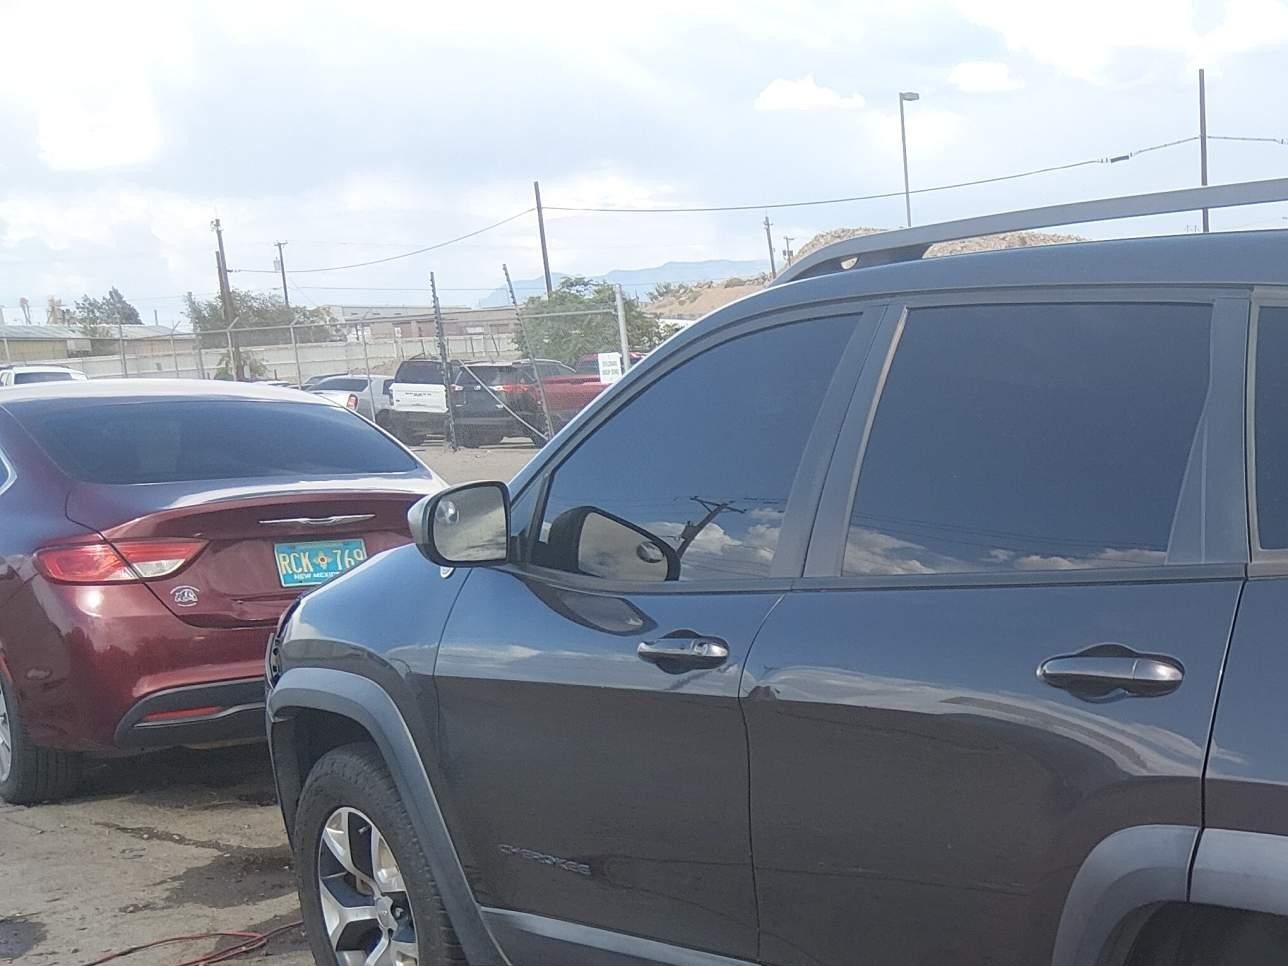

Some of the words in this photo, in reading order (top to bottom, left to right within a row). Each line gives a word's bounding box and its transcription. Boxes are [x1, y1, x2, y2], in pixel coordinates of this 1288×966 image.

[278, 551, 314, 575] RCK
[332, 548, 364, 570] 769
[293, 572, 312, 580] NEW
